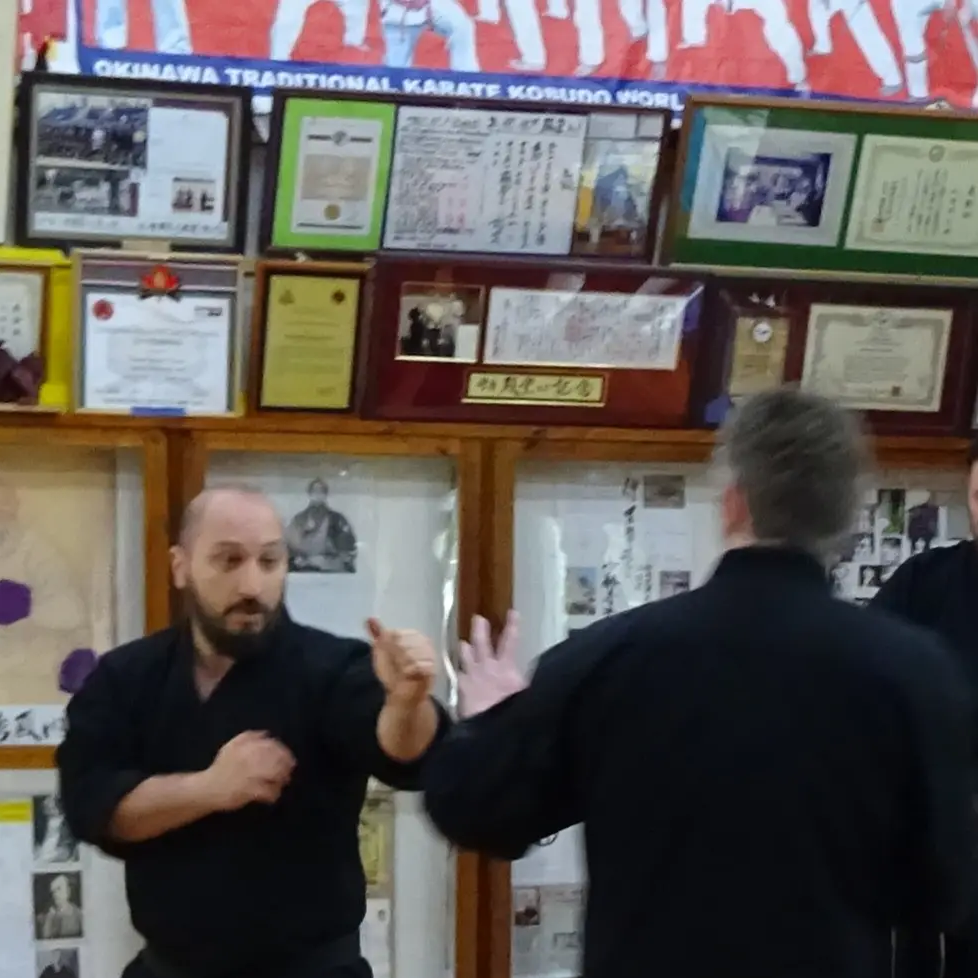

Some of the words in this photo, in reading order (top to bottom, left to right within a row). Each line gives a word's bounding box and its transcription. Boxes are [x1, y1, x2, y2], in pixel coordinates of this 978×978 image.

[93, 59, 220, 85] OKINAWA
[224, 67, 398, 92] TRADITIONAL
[401, 78, 501, 98] KARATE
[506, 84, 613, 104] KOBUDO
